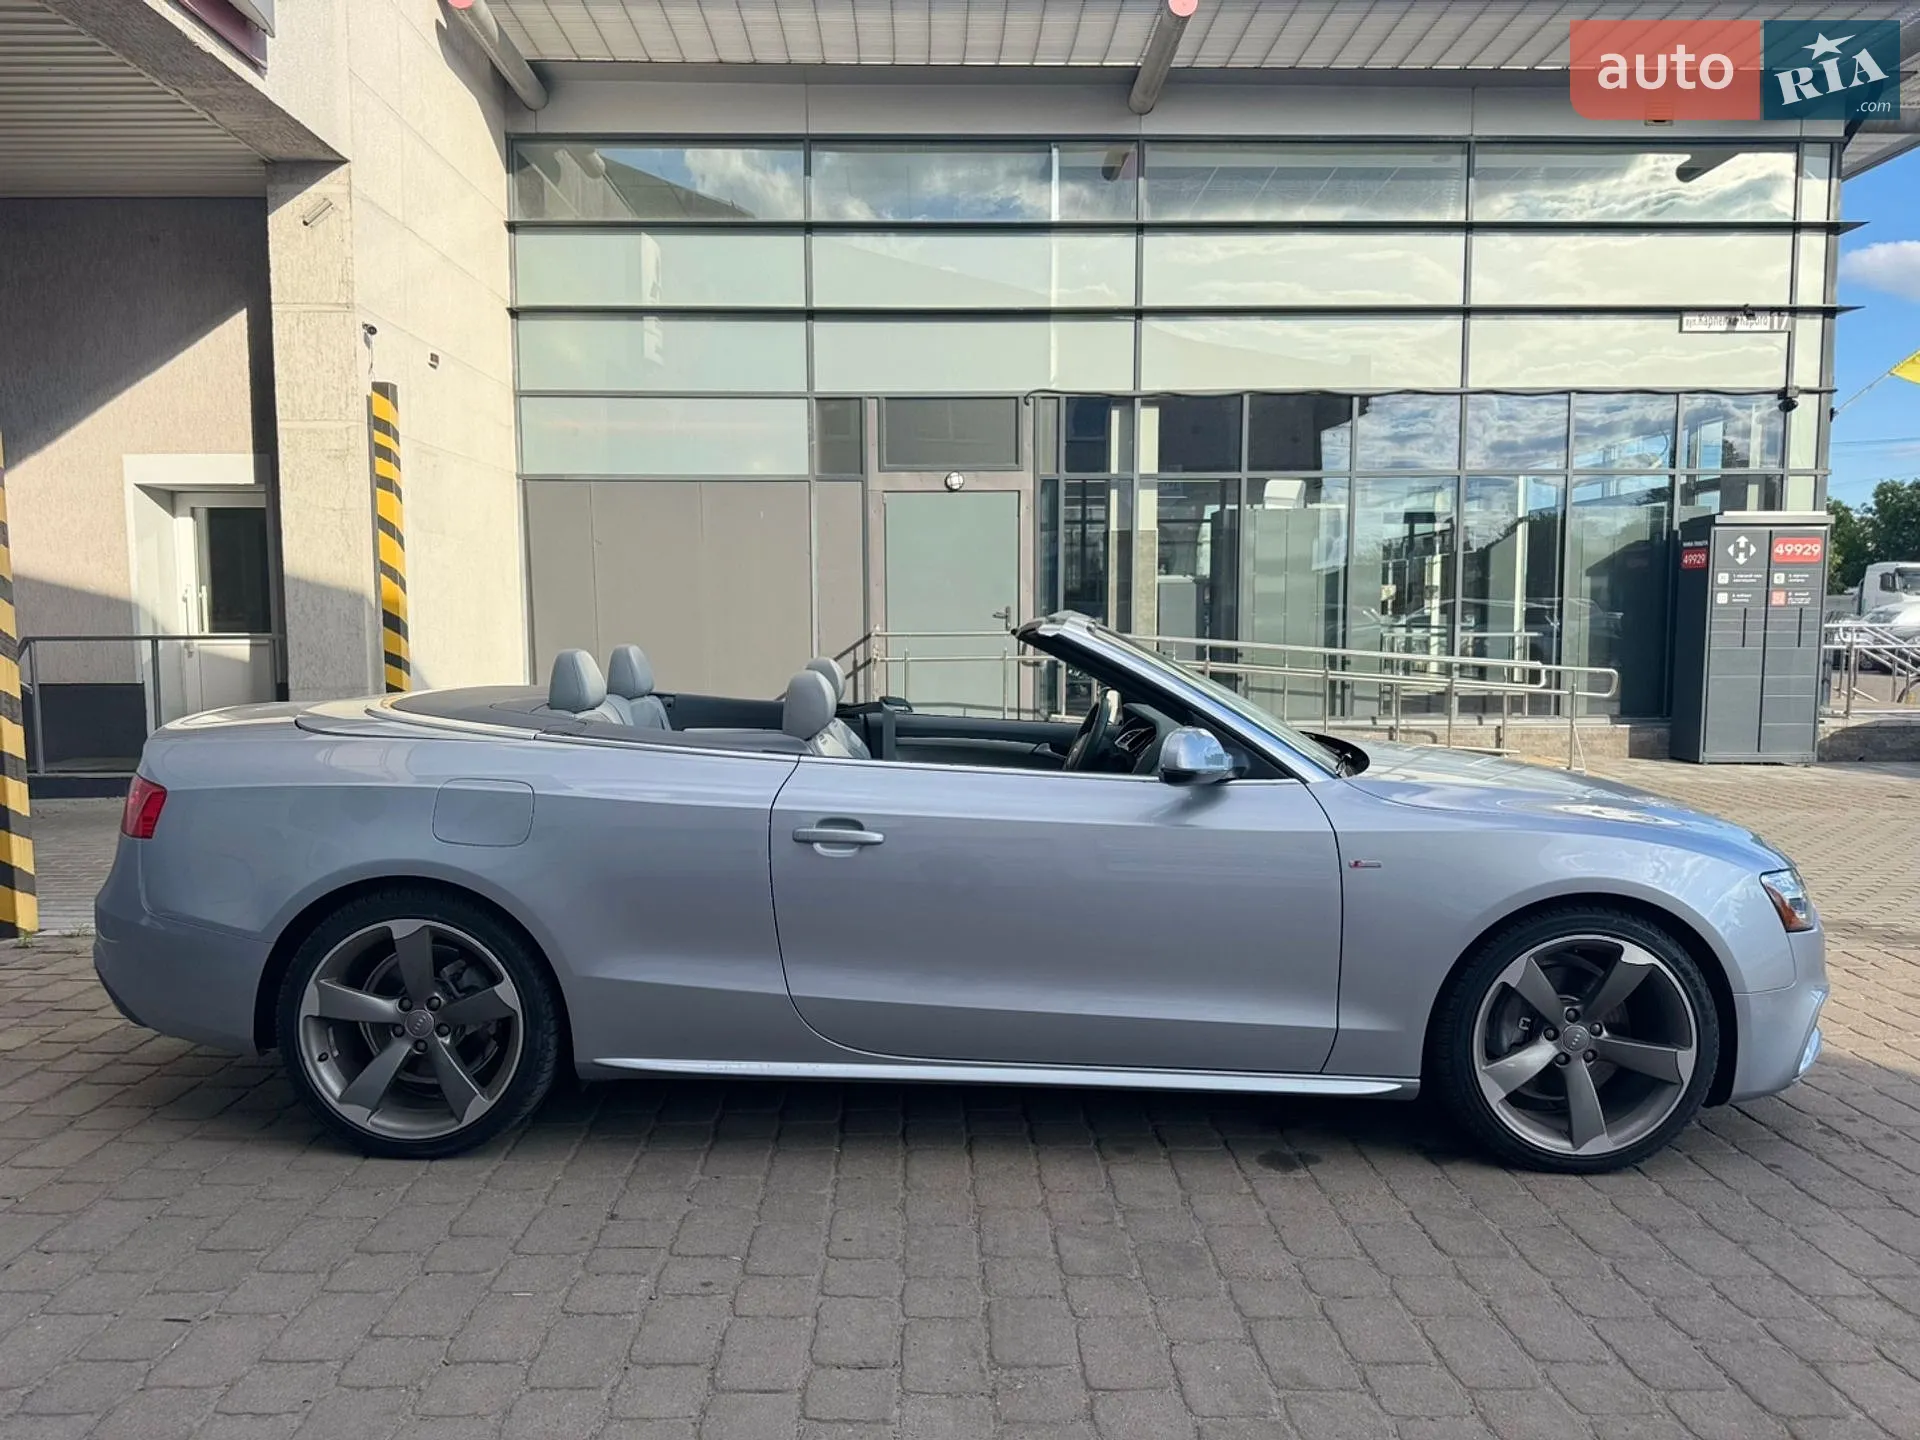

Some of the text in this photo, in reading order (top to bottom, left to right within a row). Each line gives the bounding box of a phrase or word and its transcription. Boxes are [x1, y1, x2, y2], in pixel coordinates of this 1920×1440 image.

[1770, 311, 1790, 330] 17
[1775, 543, 1821, 556] 49929
[1682, 553, 1706, 565] 49929
